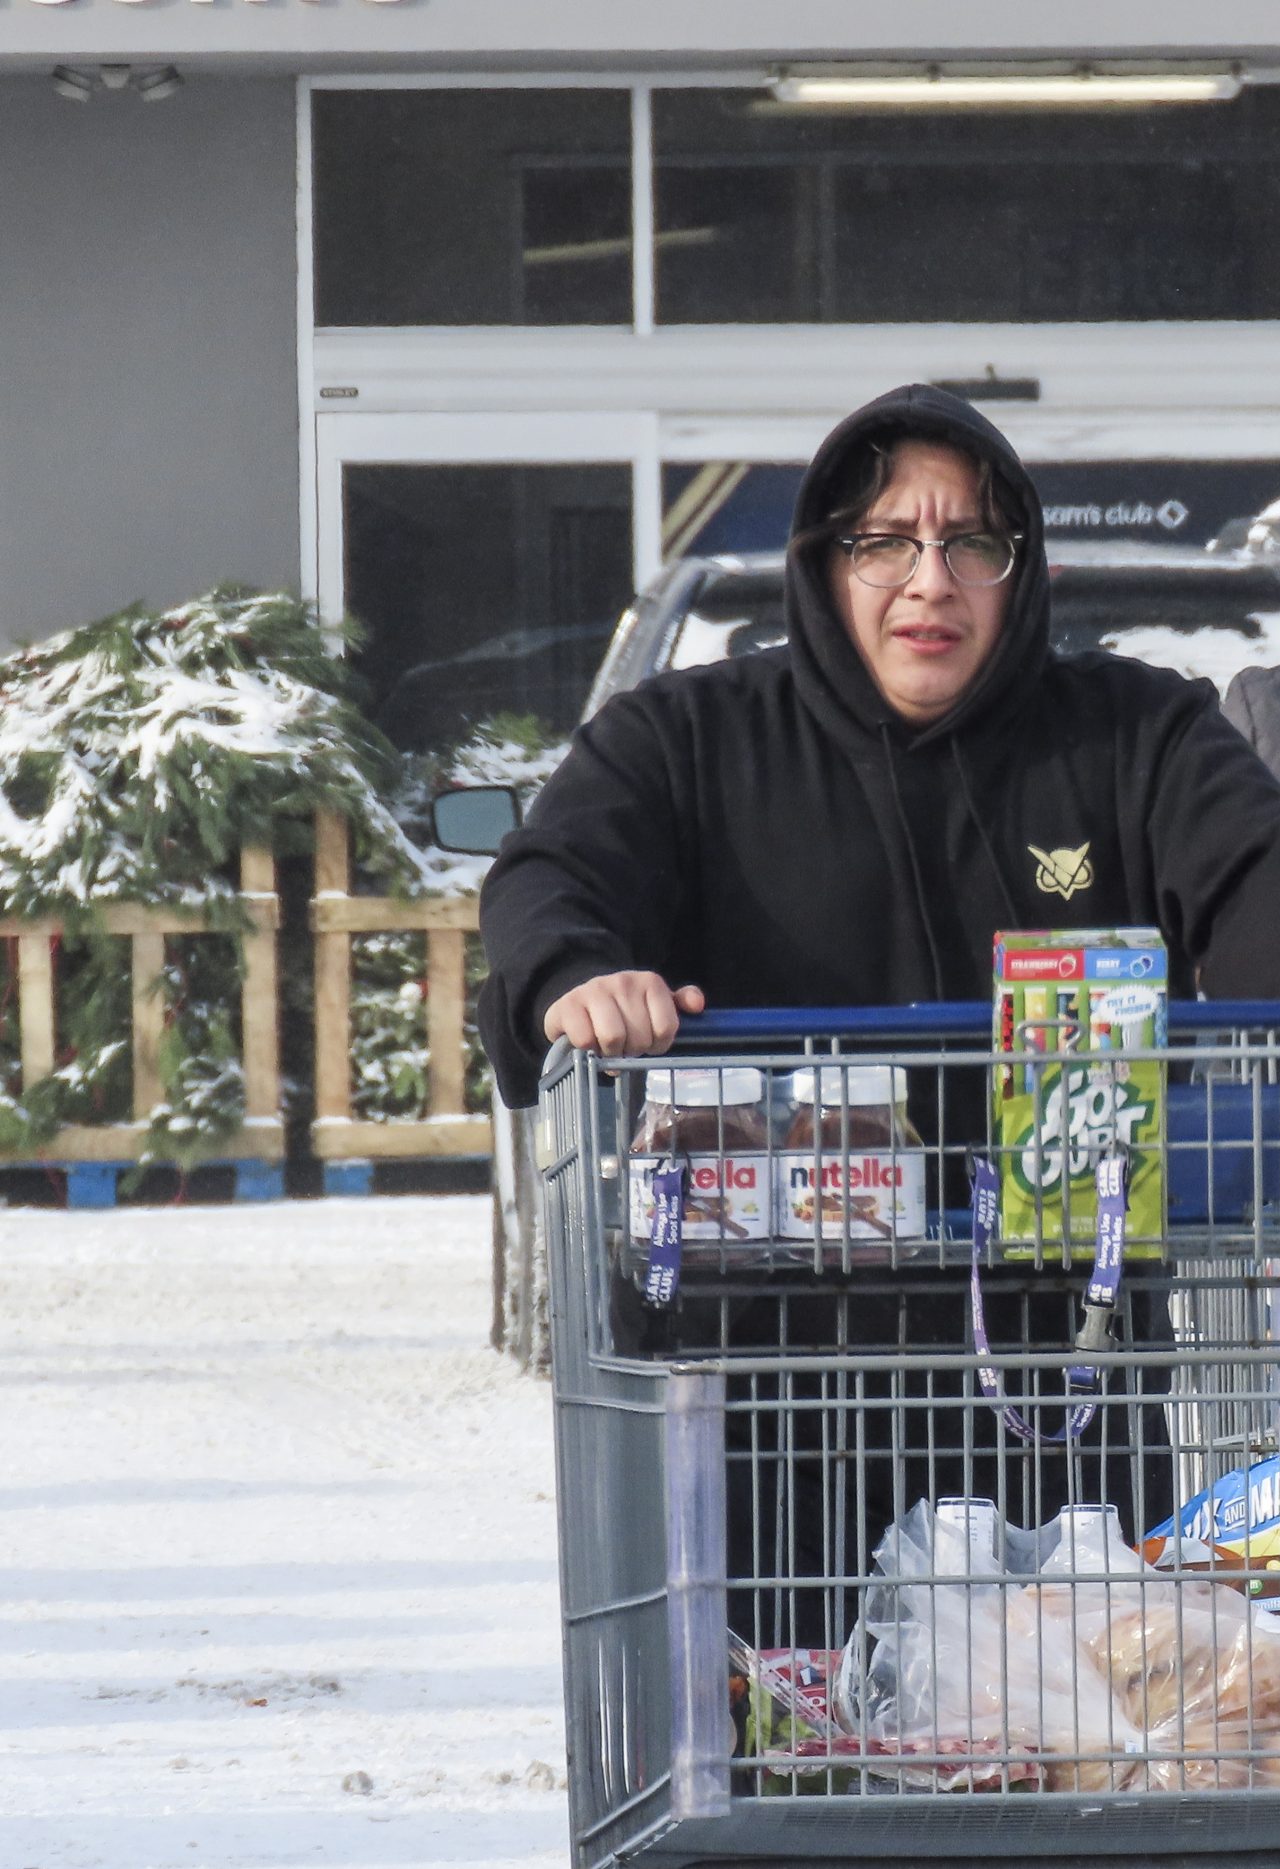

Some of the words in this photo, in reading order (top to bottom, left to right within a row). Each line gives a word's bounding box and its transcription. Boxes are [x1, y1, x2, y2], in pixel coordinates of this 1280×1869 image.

[1105, 502, 1153, 526] club
[790, 1157, 903, 1189] nutella
[1225, 1501, 1246, 1526] AND
